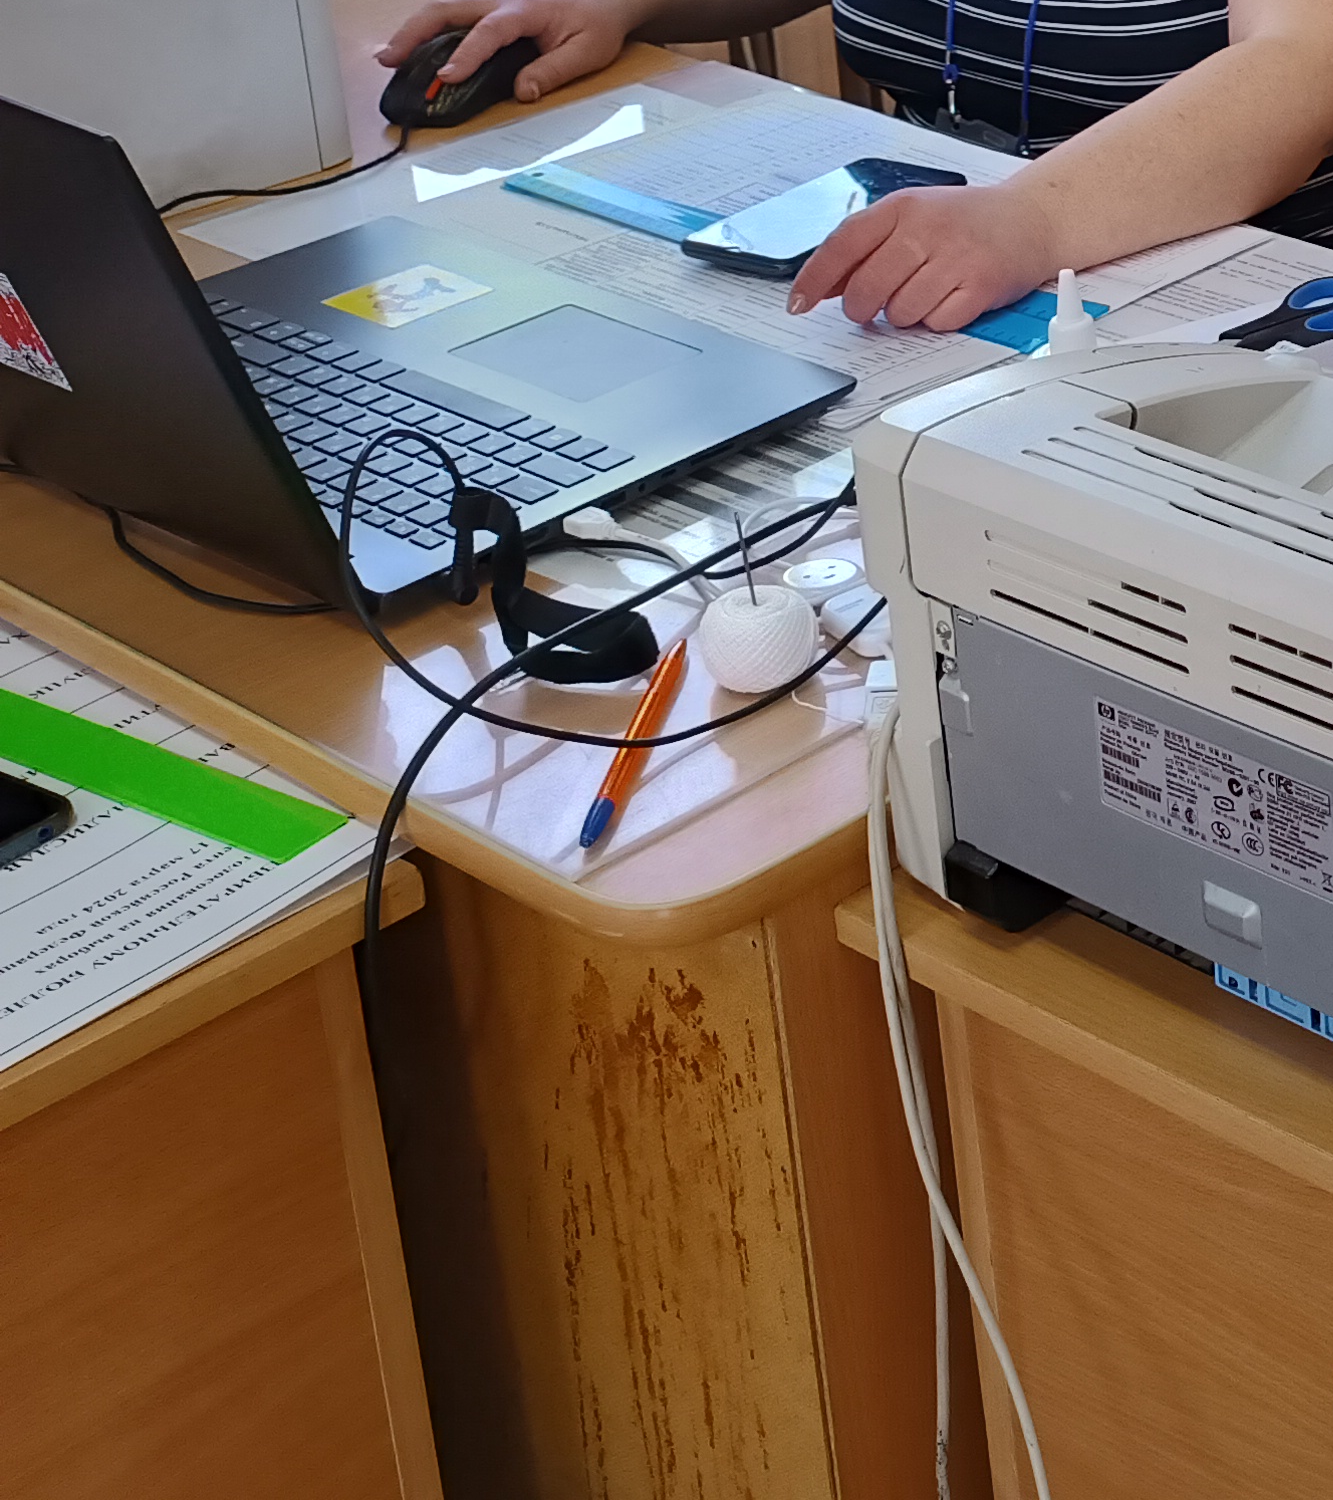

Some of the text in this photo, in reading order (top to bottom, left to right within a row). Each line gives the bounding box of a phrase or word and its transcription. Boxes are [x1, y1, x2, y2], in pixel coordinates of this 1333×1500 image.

[3, 803, 126, 874] ЛАДИСЛАВ
[34, 855, 252, 975] голосования на выборах
[35, 841, 209, 936] 17 марта 2024 года
[89, 872, 193, 929] Российской
[0, 860, 280, 1020] ЗБИРАТЕЛЬНОМУ БЮЛЛЕ
